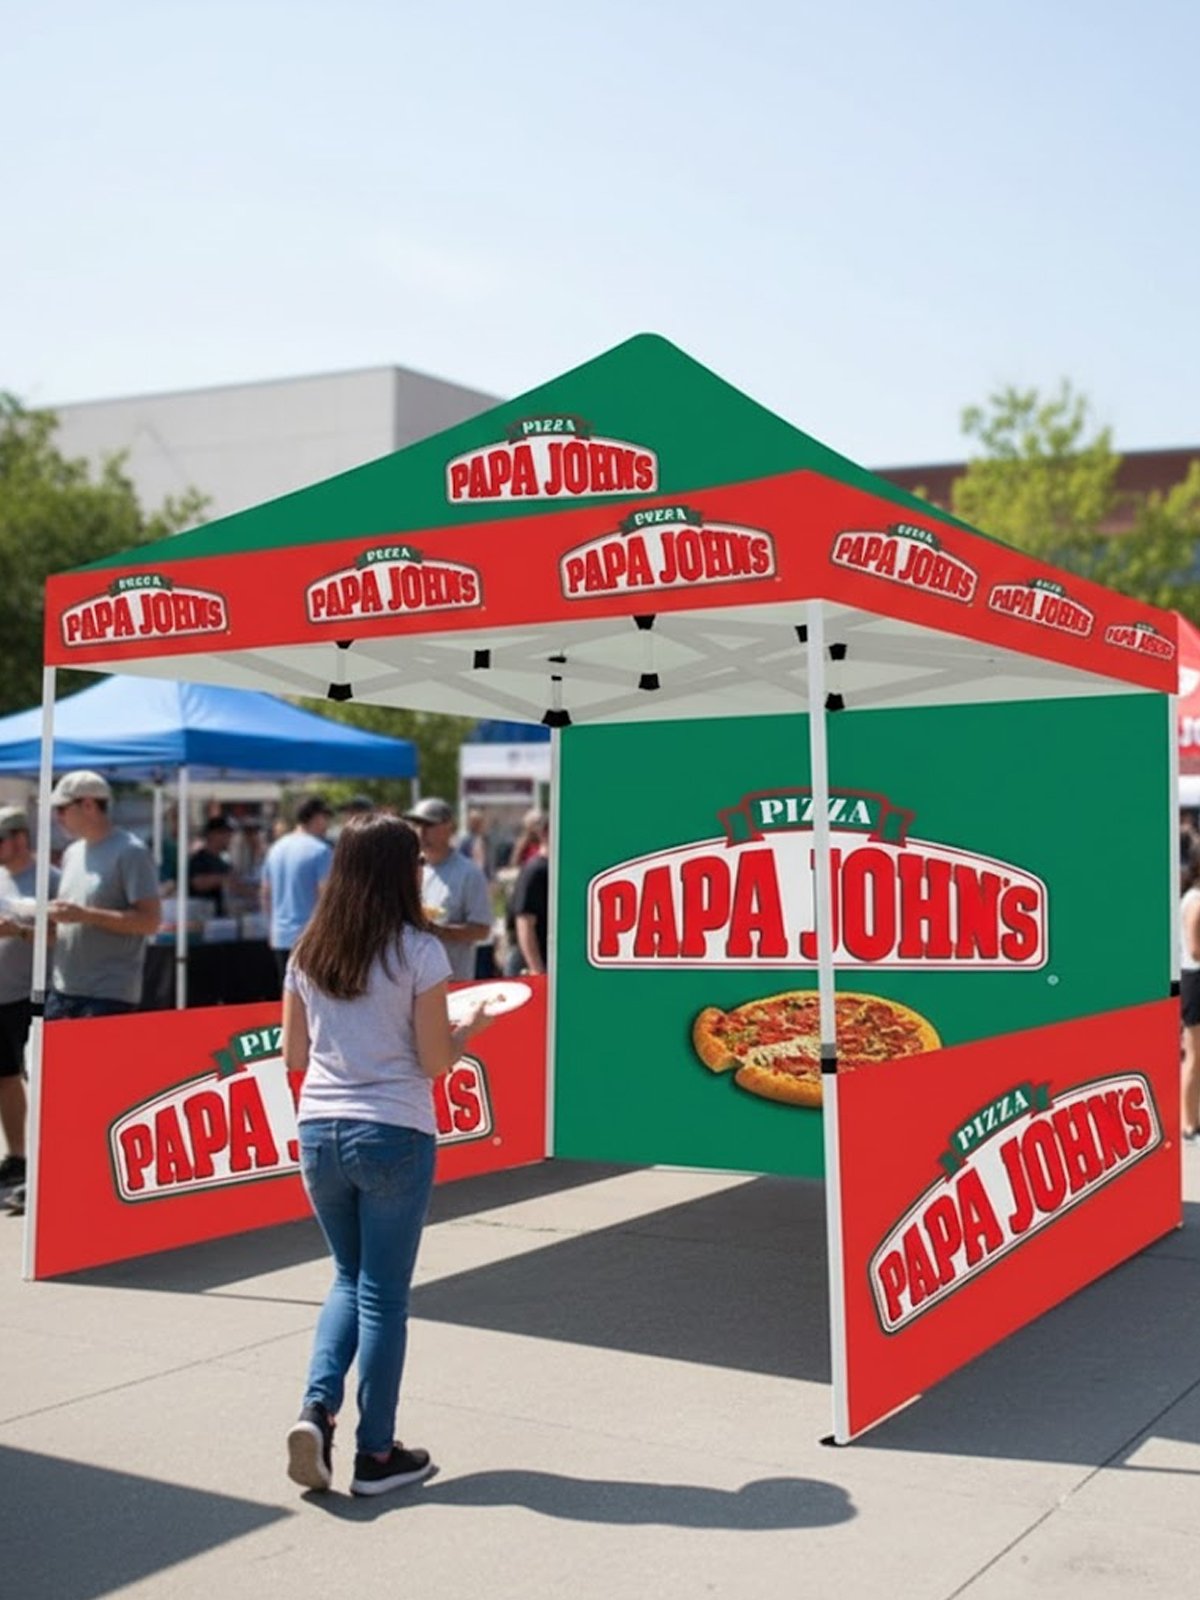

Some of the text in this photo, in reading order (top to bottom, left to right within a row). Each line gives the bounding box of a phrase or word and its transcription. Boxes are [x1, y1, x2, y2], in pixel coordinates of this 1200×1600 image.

[451, 444, 539, 500] PAPA
[565, 536, 654, 594] PAPA
[835, 536, 898, 577] PAPA
[65, 596, 136, 642] PAPA
[310, 569, 384, 618] PAPA
[759, 797, 872, 824] PIZZA
[598, 846, 1039, 962] PAPA JOHN'S
[119, 1075, 279, 1191] PAPA
[956, 1089, 1030, 1150] PIZZA
[877, 1086, 1152, 1322] PAPA JOHN'S
